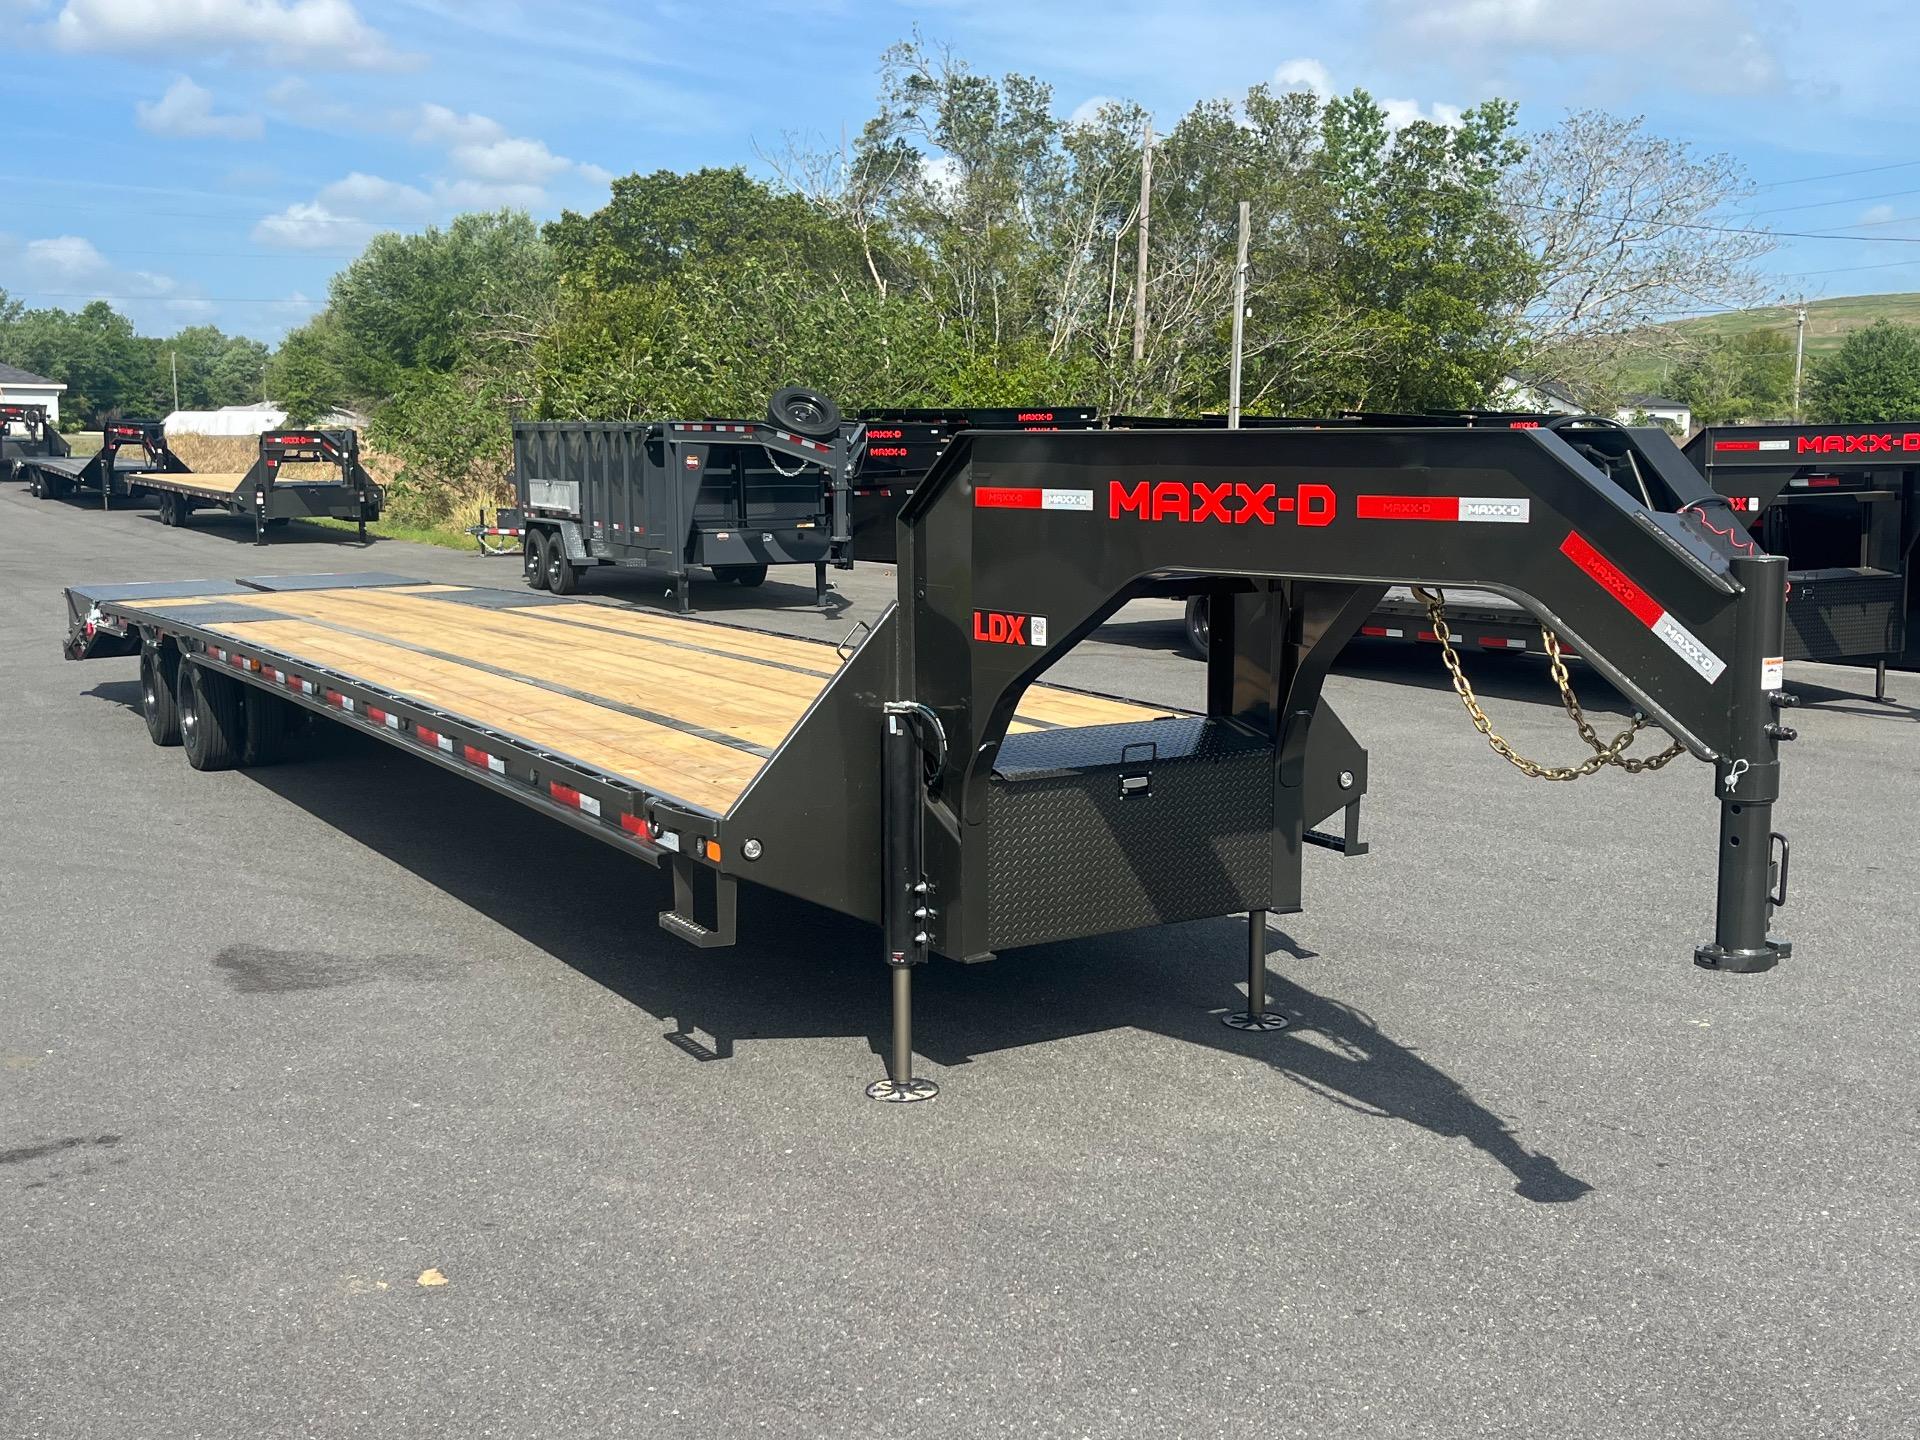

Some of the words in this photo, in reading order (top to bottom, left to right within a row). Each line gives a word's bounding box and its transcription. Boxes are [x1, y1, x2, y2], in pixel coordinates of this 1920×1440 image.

[1018, 413, 1053, 421] MAXX-D
[1797, 433, 1920, 453] MAXX-D
[868, 448, 907, 456] MAXX-D
[1048, 496, 1086, 505] MAXX-D
[1109, 480, 1336, 527] MAXX-D
[1383, 503, 1431, 513] MAXX-D
[1467, 504, 1520, 515] MAXX-D
[1586, 556, 1635, 601] MAXX-D
[973, 611, 1026, 645] LDX
[1663, 623, 1714, 670] MAXX-D
